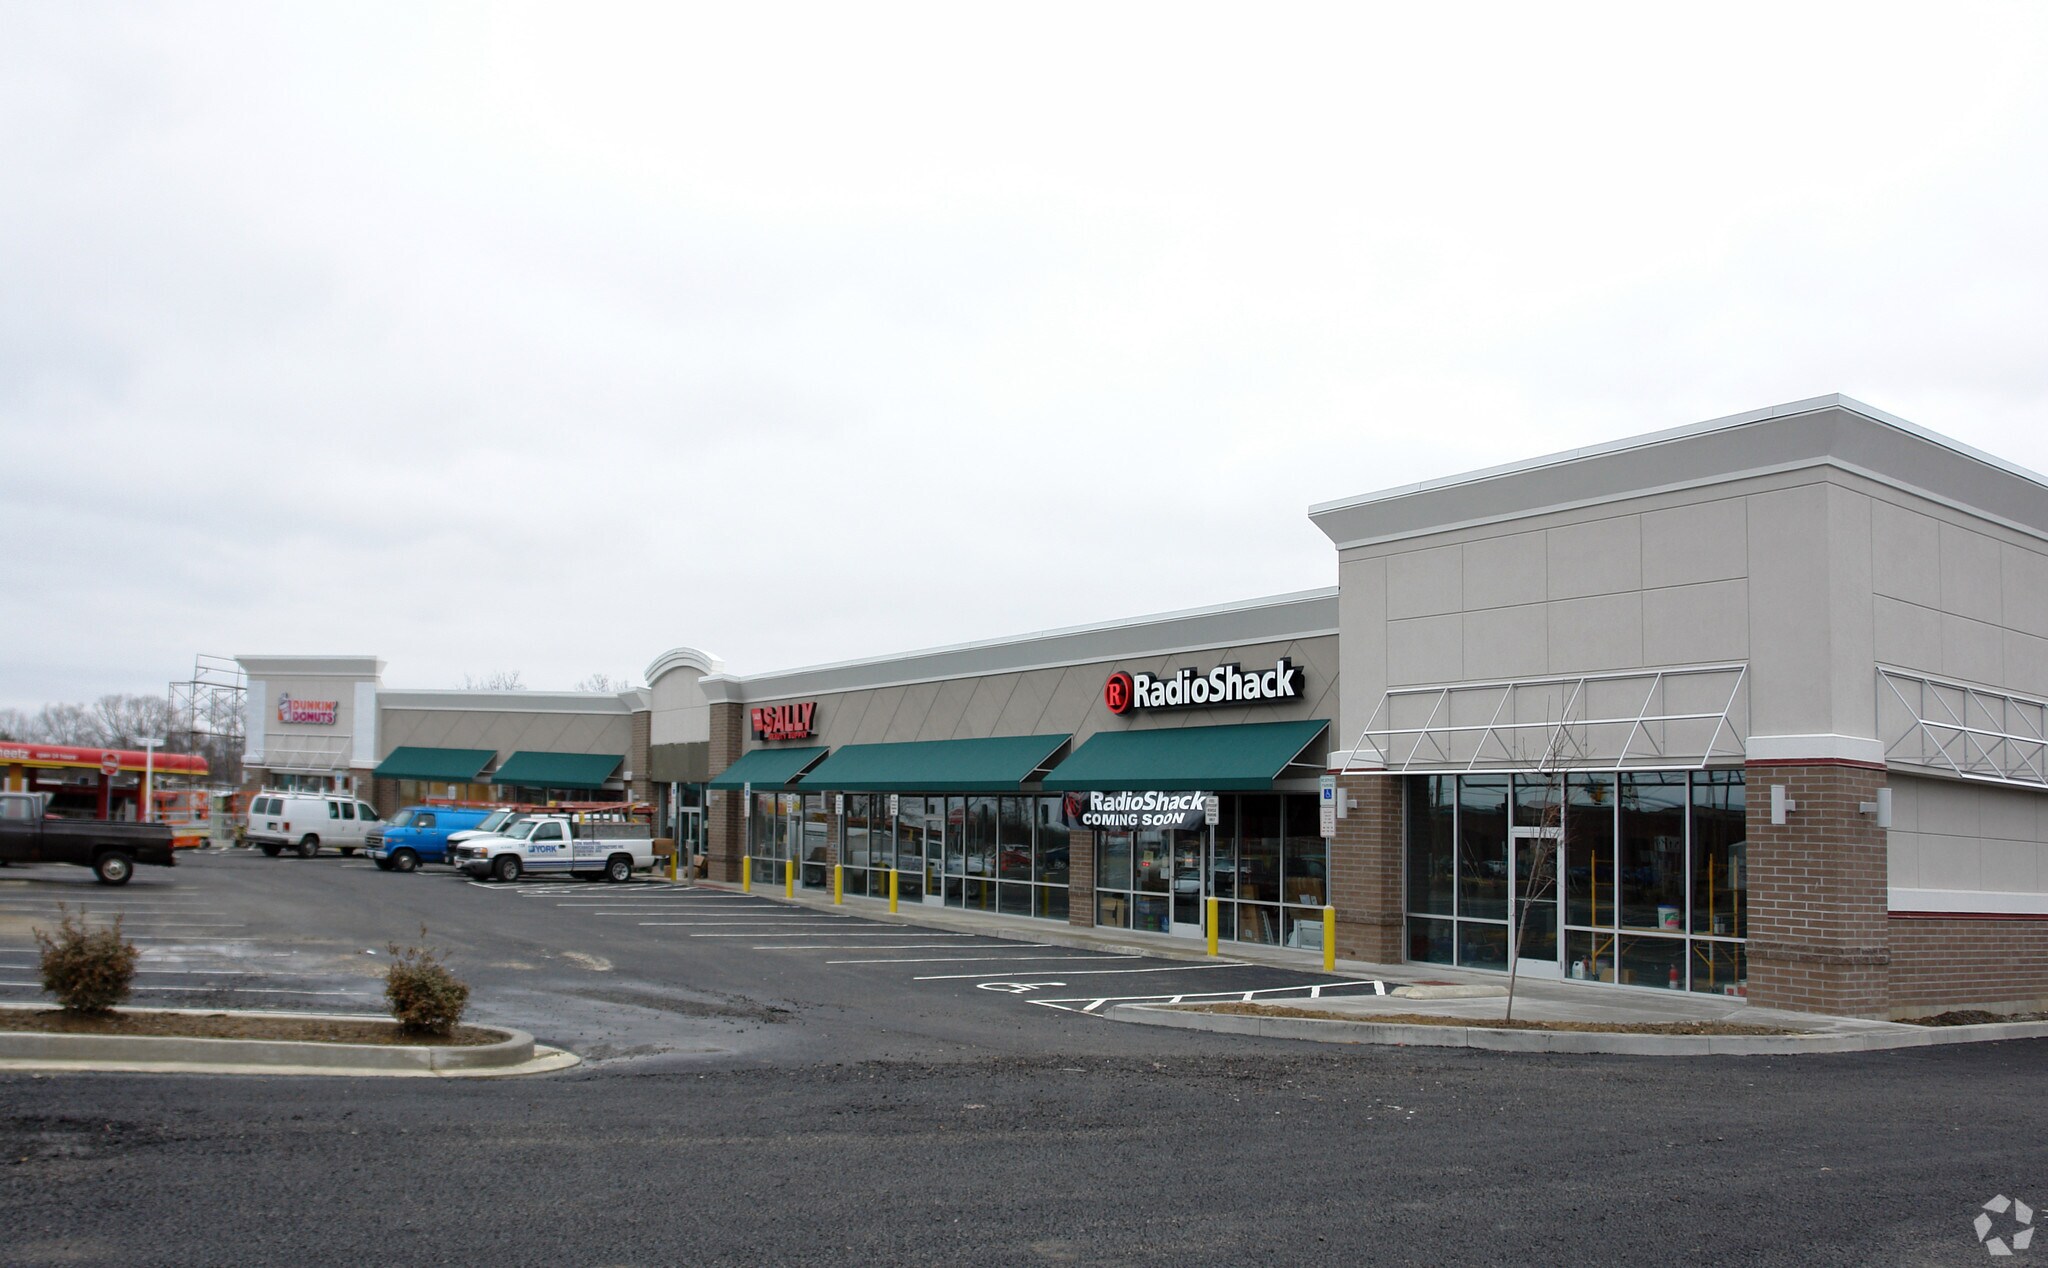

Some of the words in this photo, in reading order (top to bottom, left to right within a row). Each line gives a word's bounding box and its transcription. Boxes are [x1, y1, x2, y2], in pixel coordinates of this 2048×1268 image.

[1133, 660, 1295, 708] RadioShack
[292, 700, 336, 711] DUNKIN'
[292, 712, 333, 723] DONUTS
[763, 702, 814, 733] SALLY
[1090, 791, 1207, 811] RadioShack
[1082, 813, 1138, 826] COMING
[1142, 812, 1186, 825] SOON
[535, 845, 557, 853] YORK
